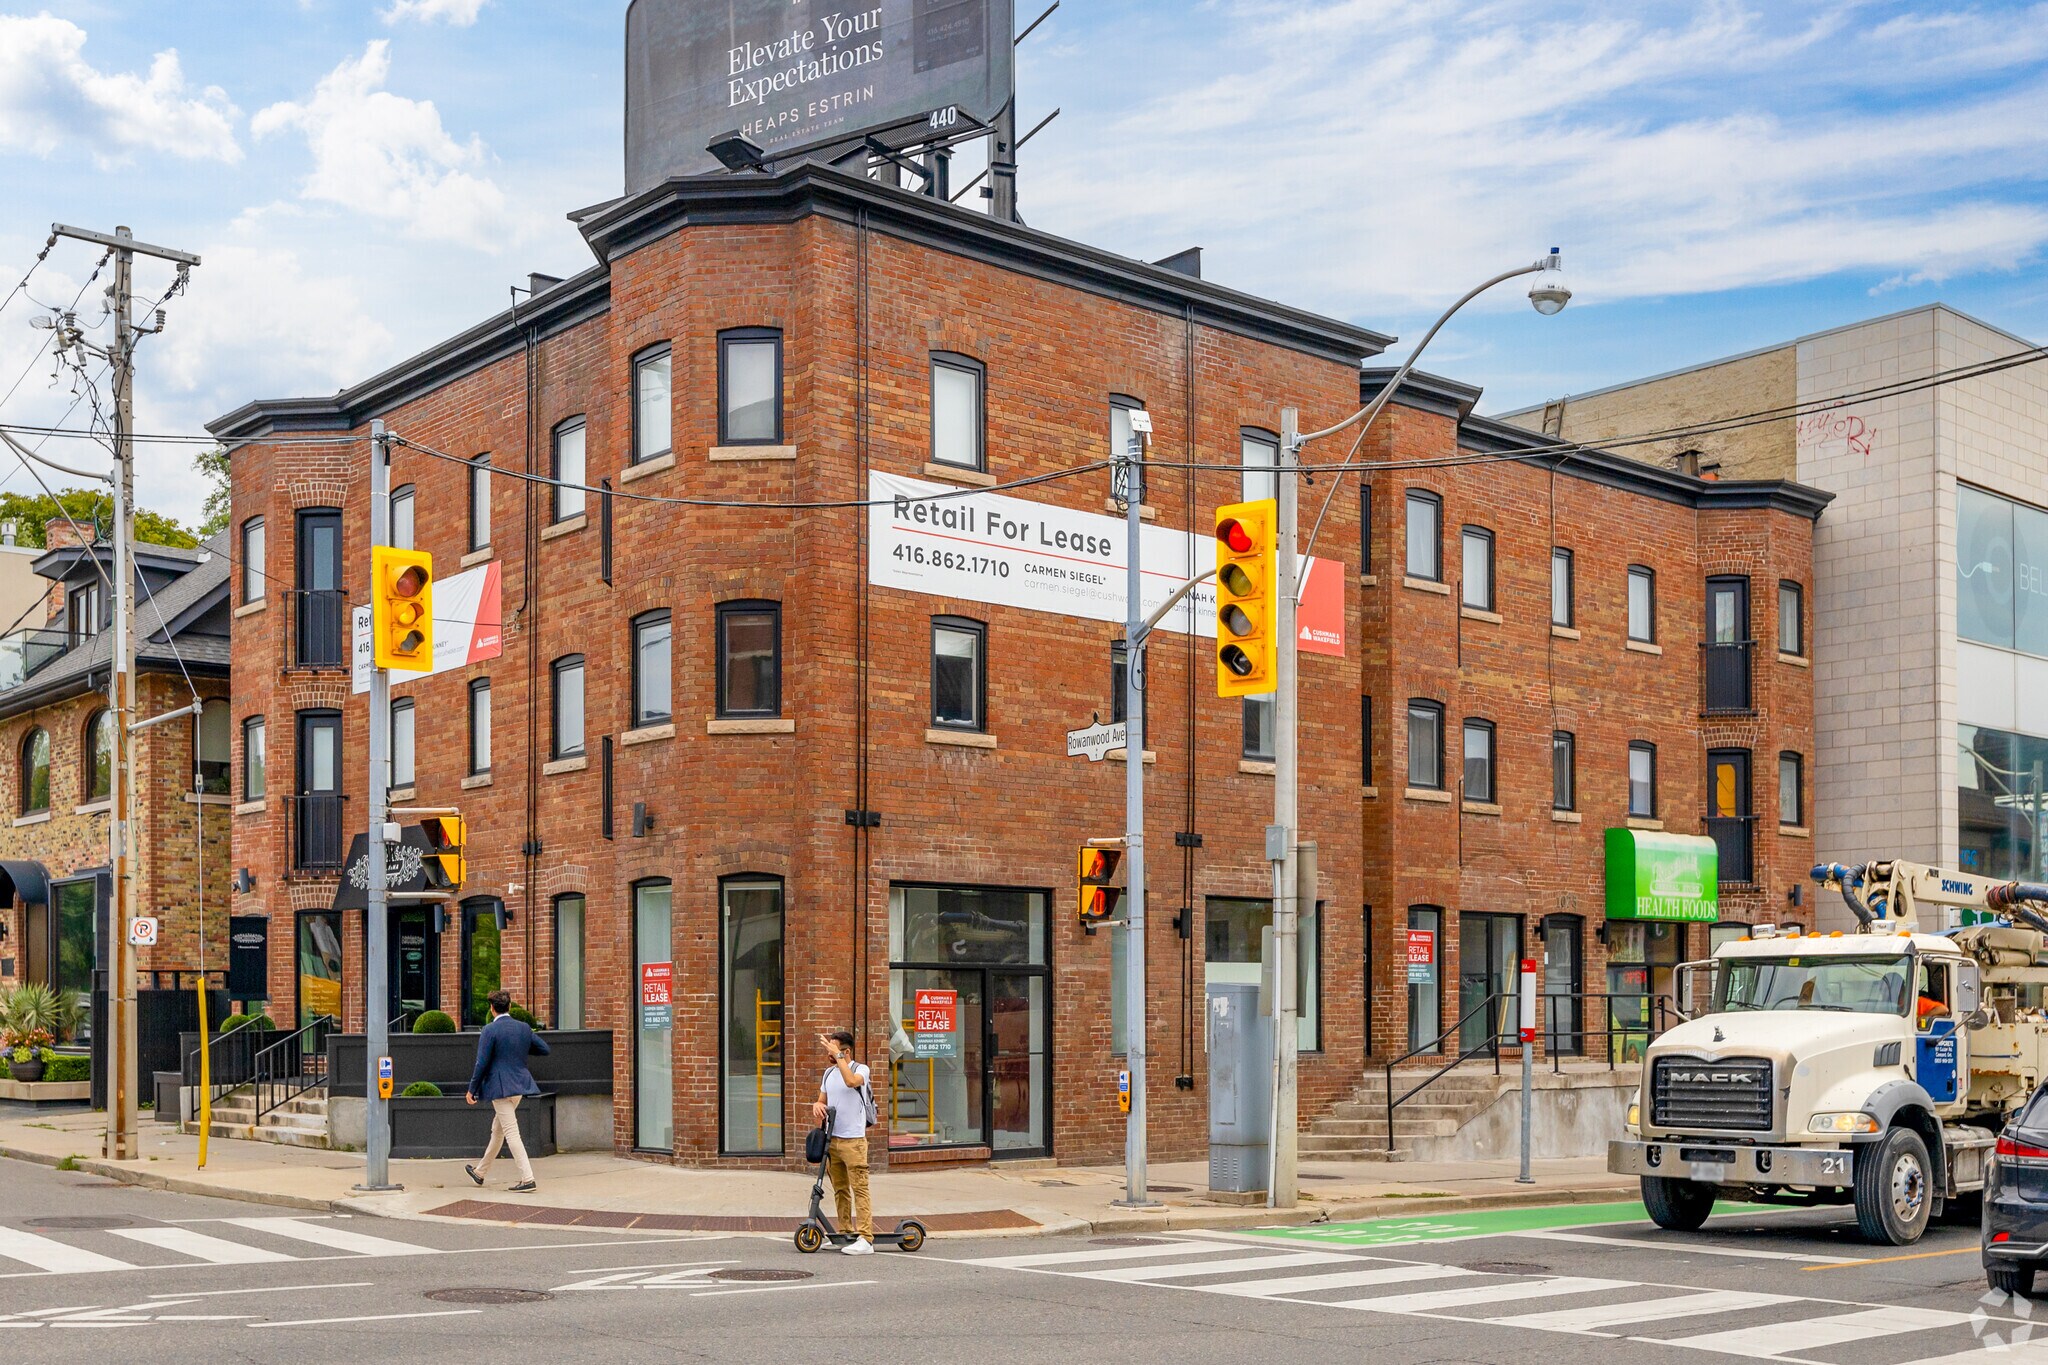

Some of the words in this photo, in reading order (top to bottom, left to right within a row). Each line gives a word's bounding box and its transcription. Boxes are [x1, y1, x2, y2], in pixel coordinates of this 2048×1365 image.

[728, 30, 814, 77] Elevate
[821, 8, 883, 45] Your
[728, 40, 884, 108] Expectations
[743, 108, 799, 137] HEAPS
[808, 85, 875, 118] ESTRIN
[929, 106, 956, 129] 440
[894, 493, 975, 532] Retail
[987, 512, 1030, 541] For
[1040, 521, 1112, 557] Lease
[892, 543, 1010, 578] 416.862.1710
[1024, 563, 1067, 579] CARMEN
[1169, 588, 1207, 603] HNNAH
[1068, 730, 1110, 749] Rowanwood
[1112, 728, 1125, 742] Ave
[1941, 879, 1973, 896] SCHWING
[1637, 896, 1680, 917] HEALTH
[1682, 899, 1717, 920] FOODS
[1408, 946, 1429, 954] RETAIL
[1411, 954, 1429, 962] LEASE
[644, 982, 668, 993] RETAIL
[646, 993, 669, 1003] LEASE
[918, 1010, 950, 1020] RETAIL
[921, 1021, 950, 1030] LEASE
[1671, 1072, 1752, 1083] MACK
[1822, 1157, 1844, 1174] 21
